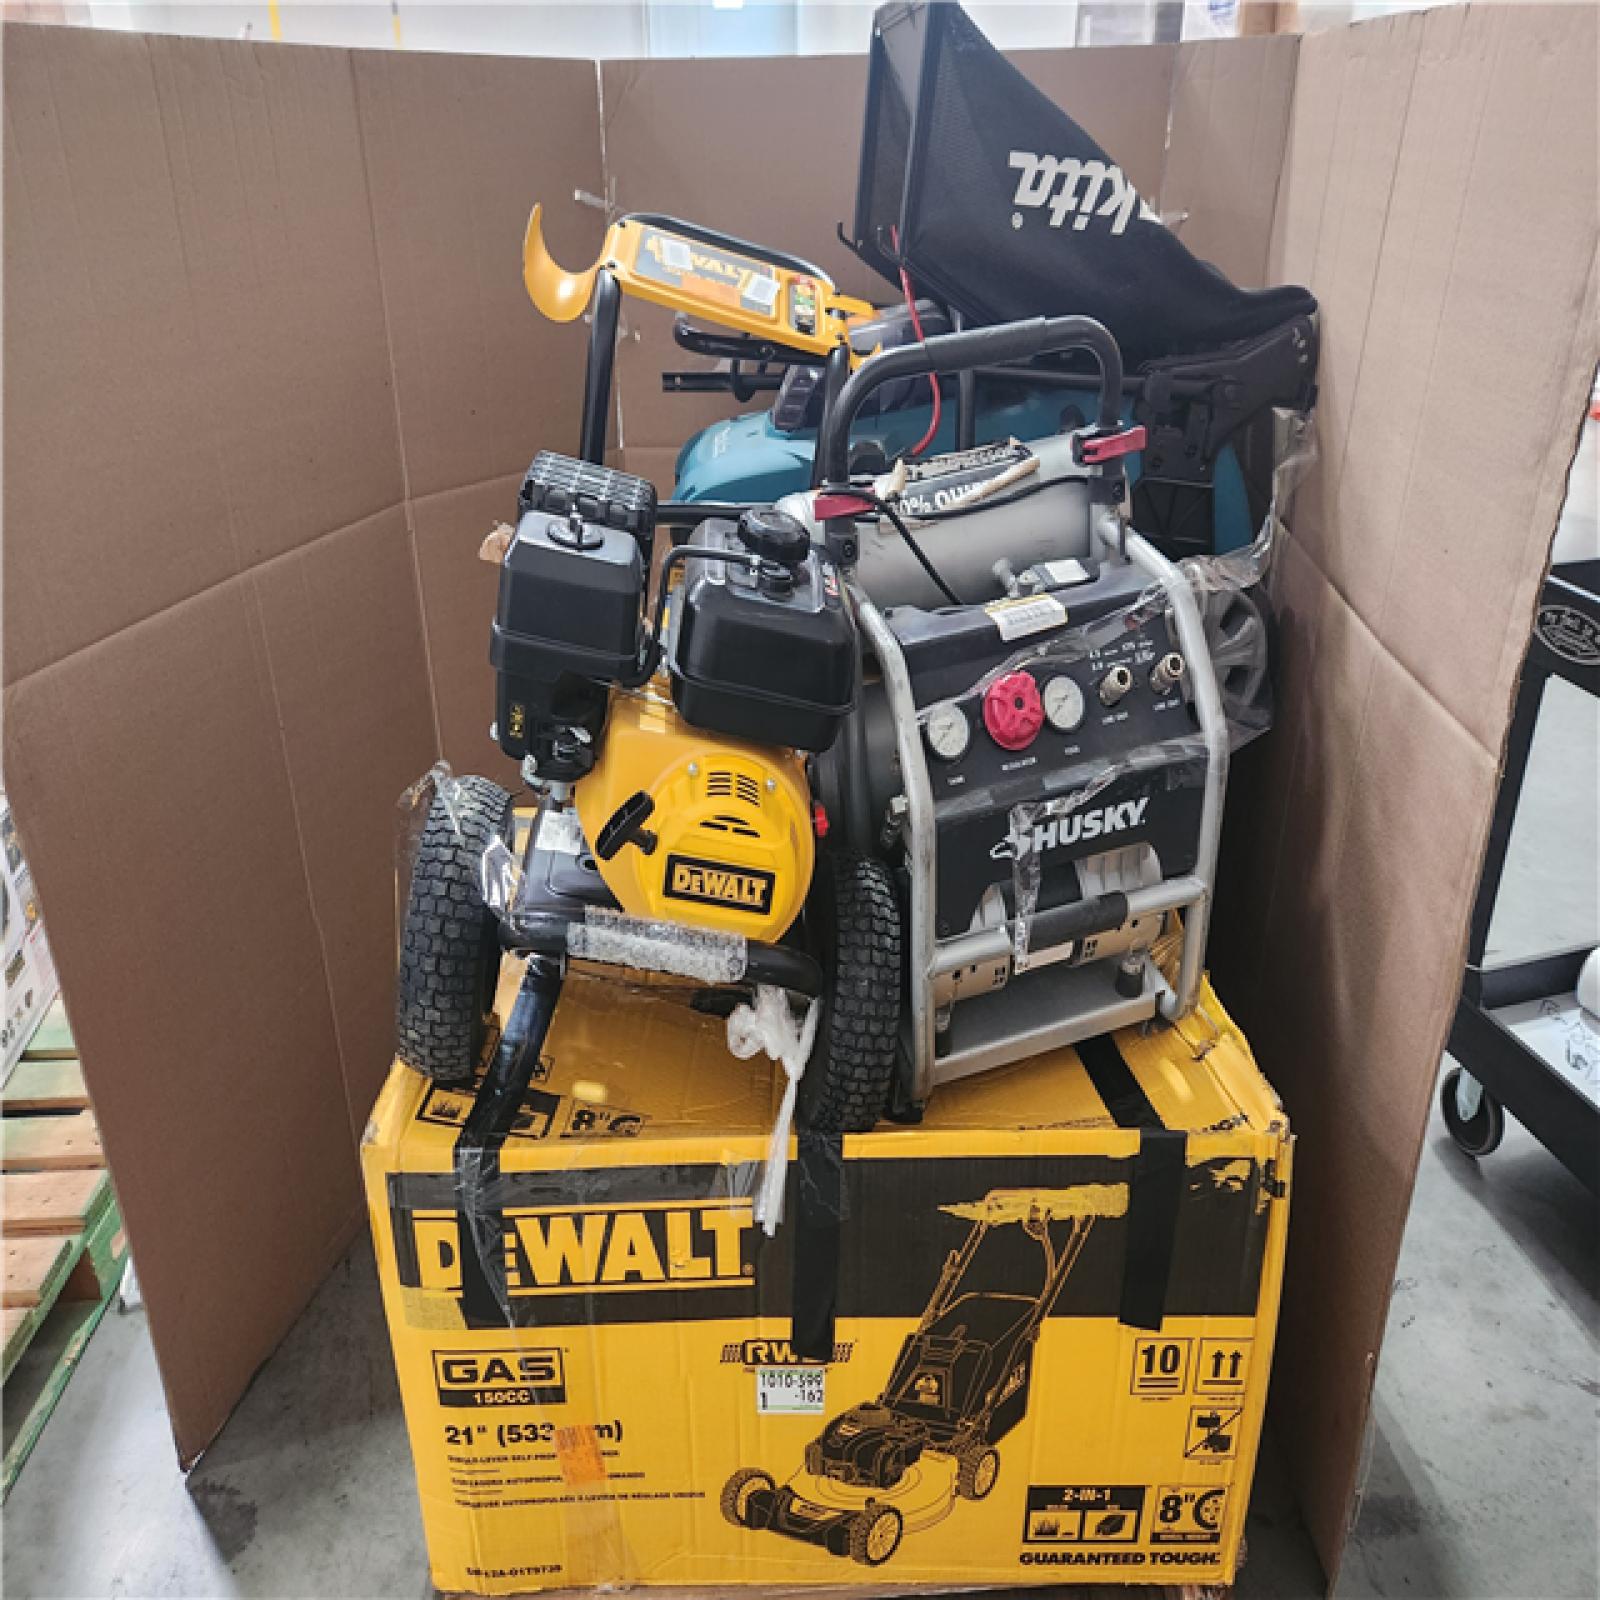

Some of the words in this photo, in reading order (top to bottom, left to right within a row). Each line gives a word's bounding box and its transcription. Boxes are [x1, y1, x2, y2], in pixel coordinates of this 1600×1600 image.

[1034, 798, 1149, 850] HUSKY
[672, 863, 768, 904] DEWALT
[412, 1209, 752, 1289] DWALT
[442, 1357, 556, 1384] GAS
[1142, 1344, 1181, 1375] 10
[445, 1425, 488, 1445] 21"
[1019, 1551, 1147, 1566] GUARANTEED
